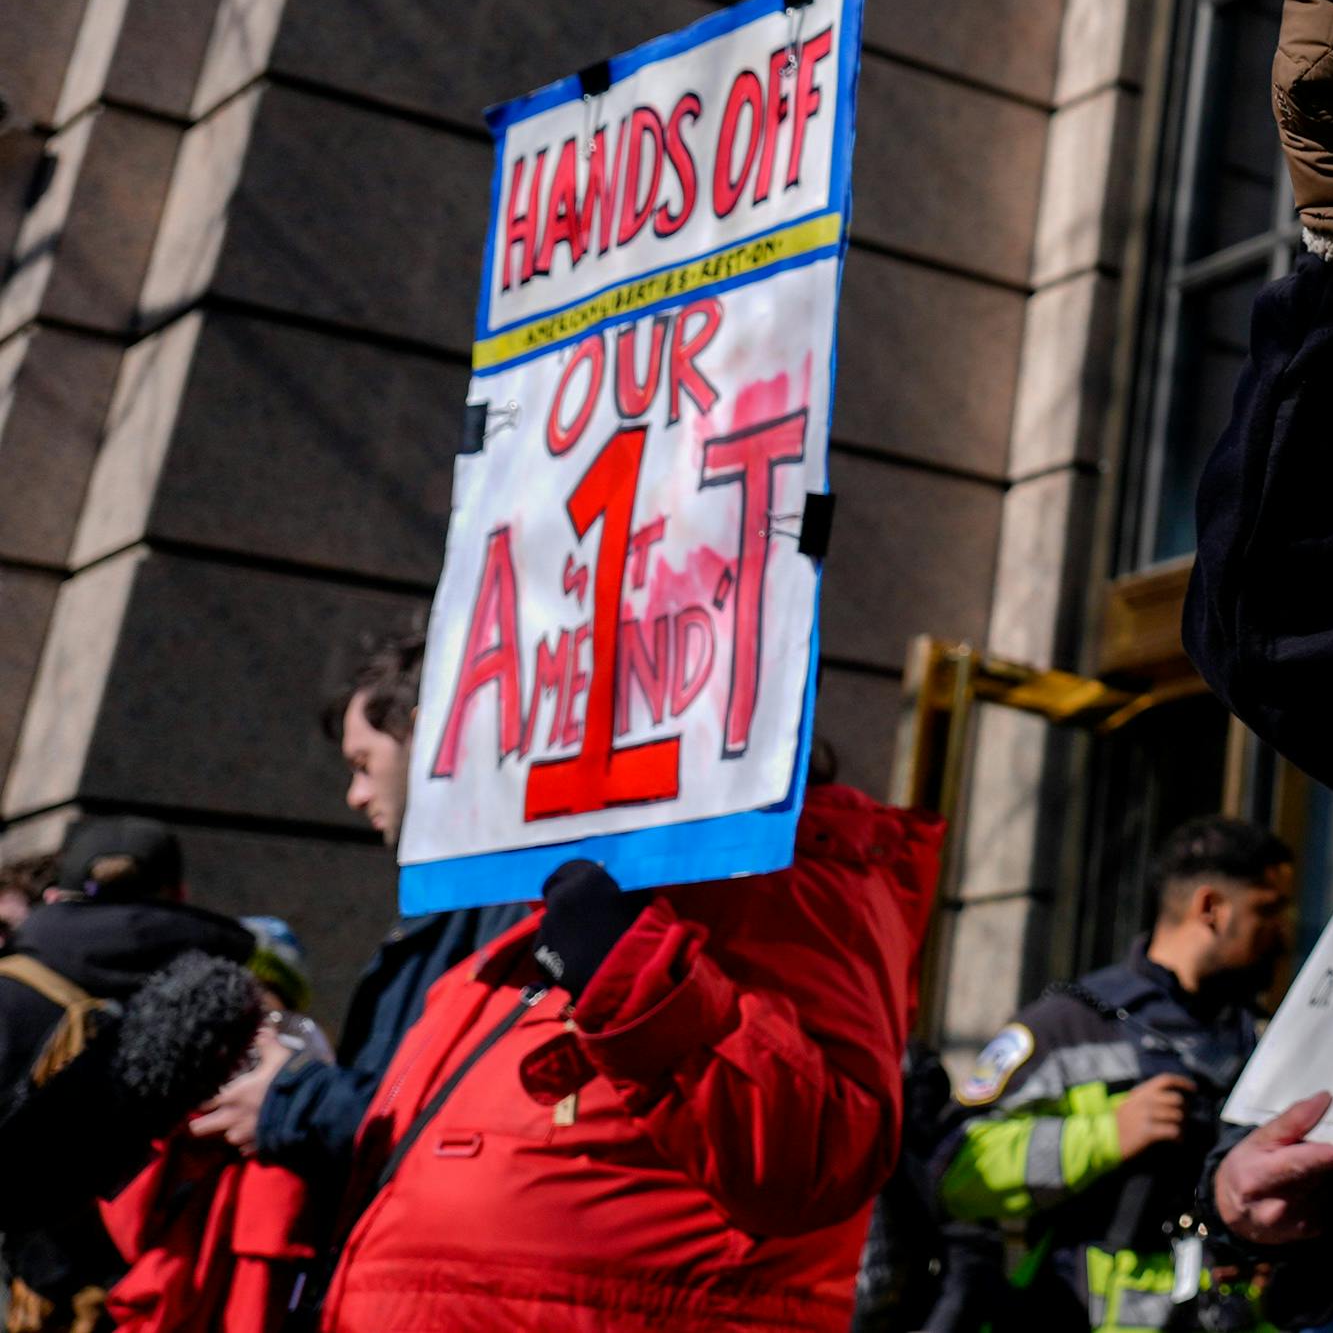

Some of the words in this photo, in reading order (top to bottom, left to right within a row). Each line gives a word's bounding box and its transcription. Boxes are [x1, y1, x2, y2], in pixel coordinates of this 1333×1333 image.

[501, 91, 702, 293] HANDS
[711, 24, 834, 219] OFF
[546, 296, 724, 457] OUR
